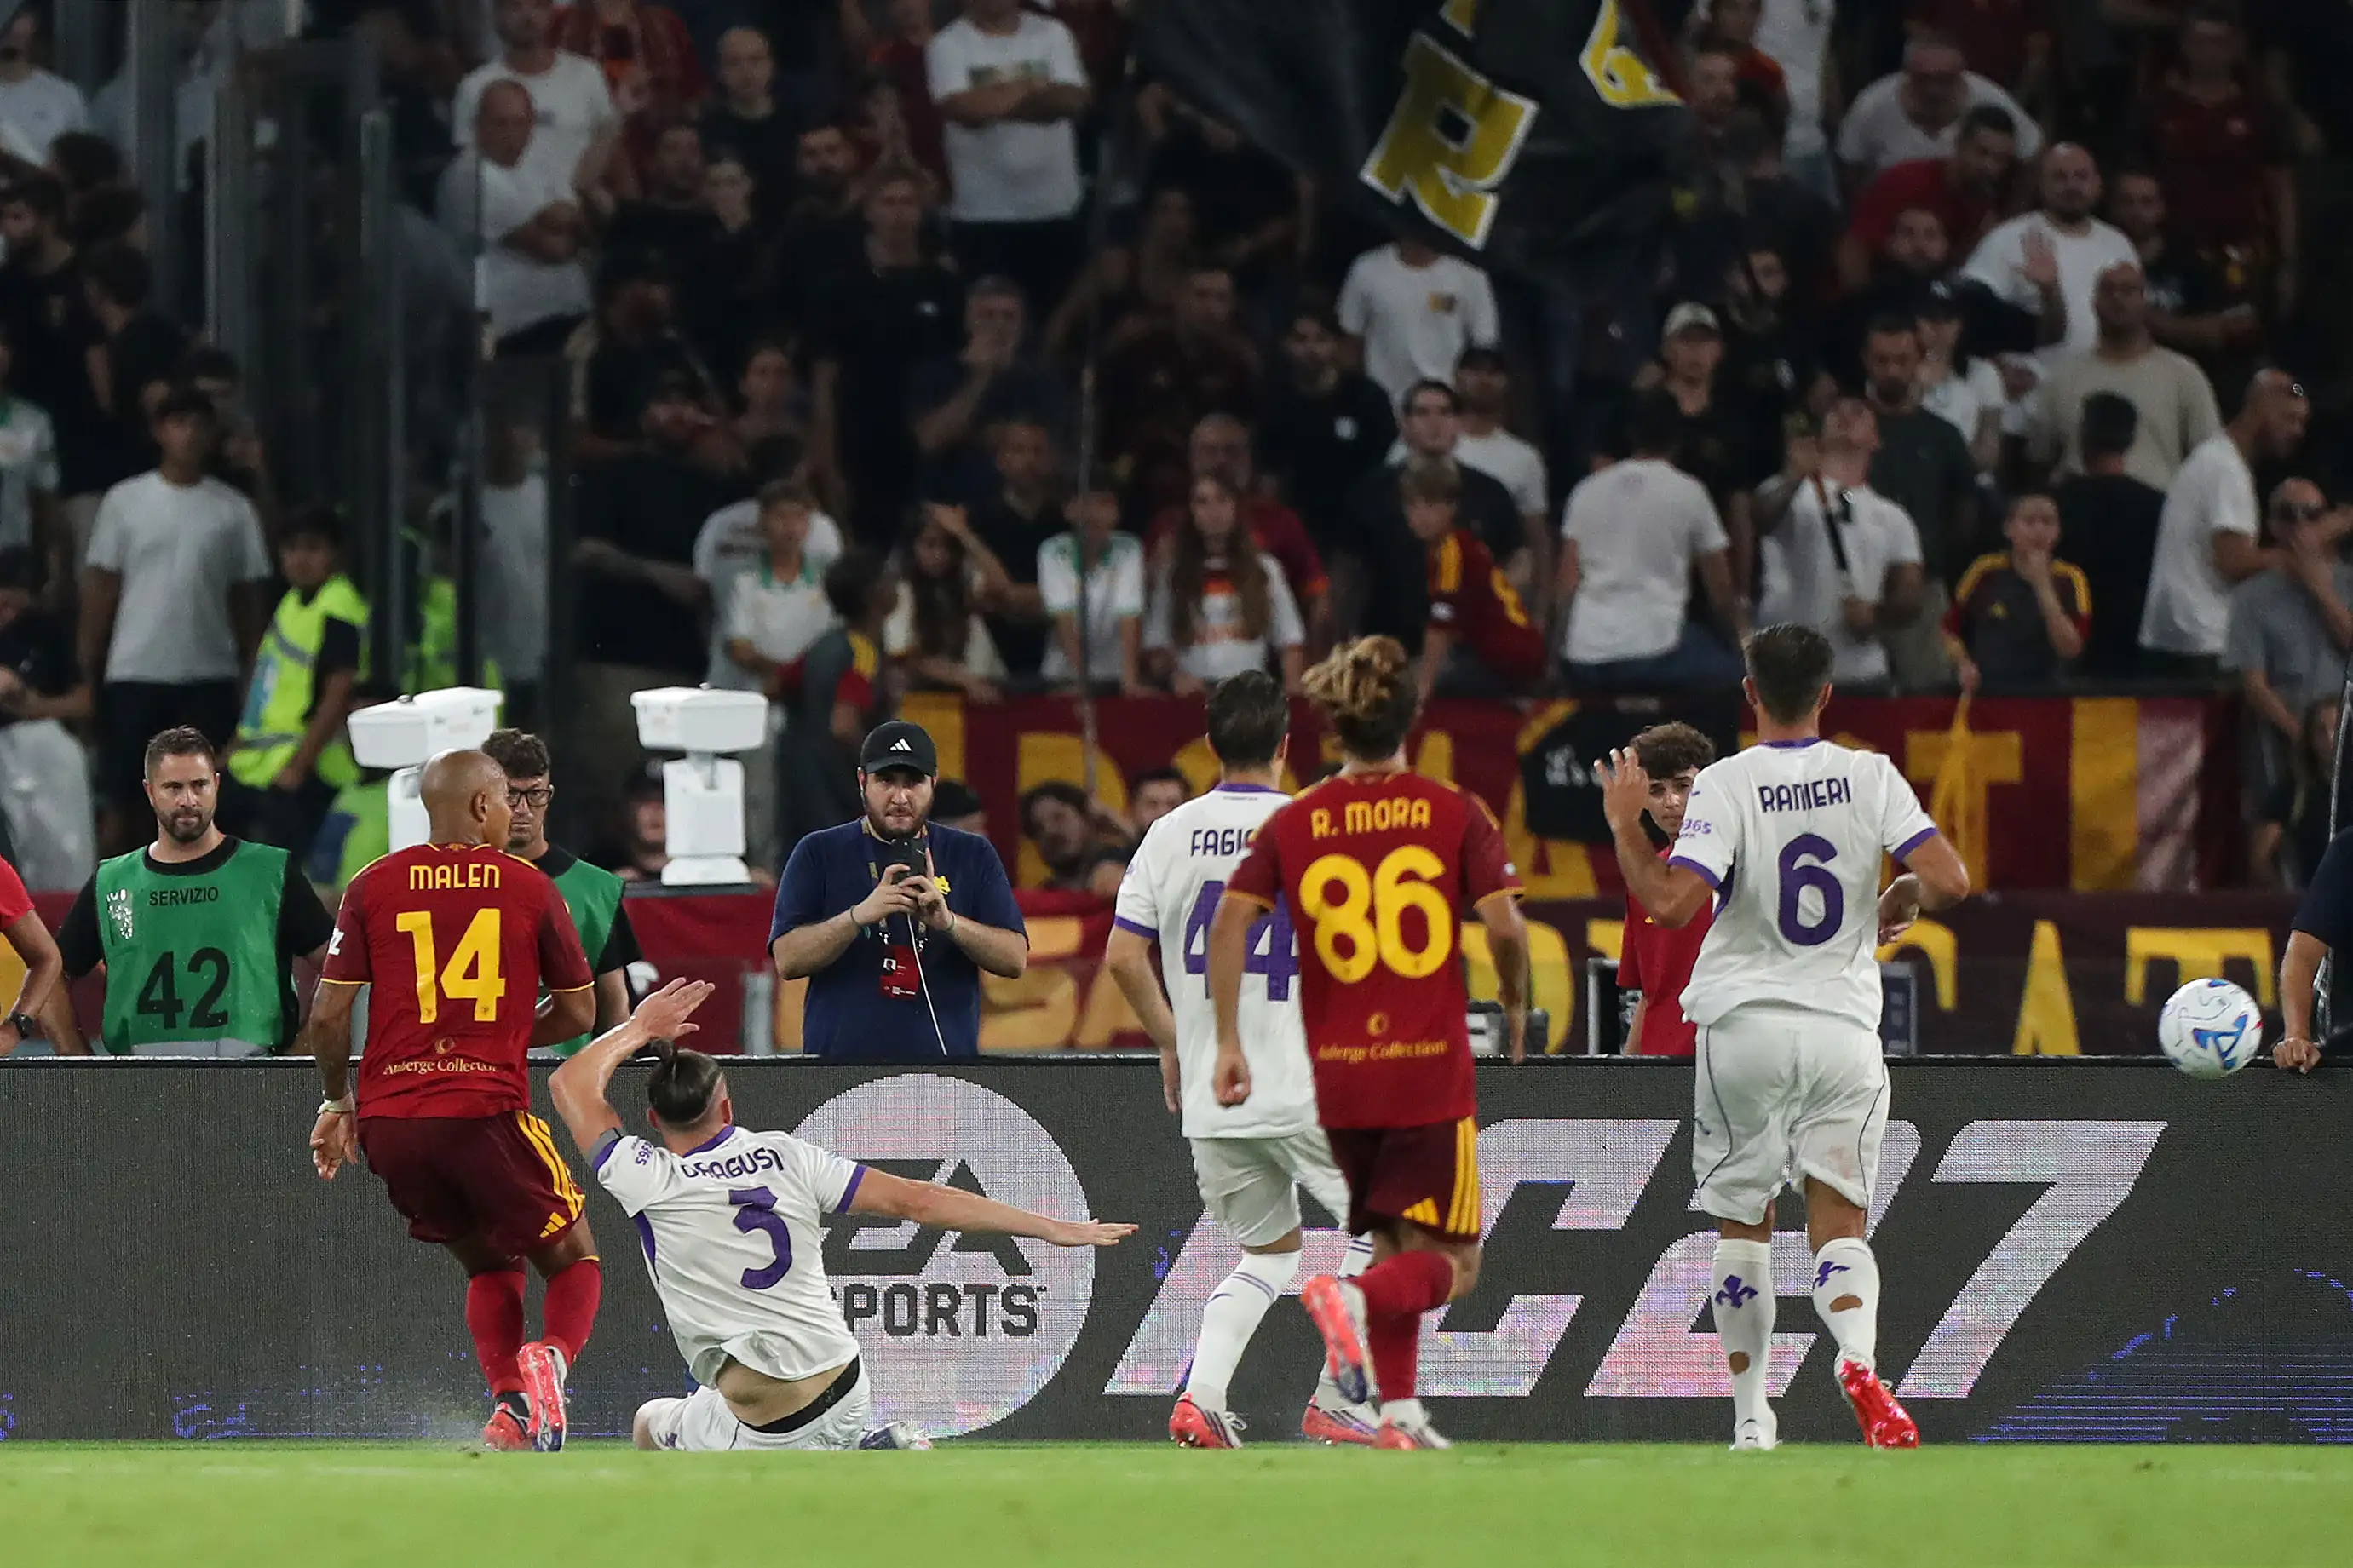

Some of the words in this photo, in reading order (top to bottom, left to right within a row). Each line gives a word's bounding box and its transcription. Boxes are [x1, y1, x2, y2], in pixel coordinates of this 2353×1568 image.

[1310, 808, 1339, 839] R.
[1344, 797, 1431, 836] MORA
[148, 887, 219, 906] SERVIZIO
[409, 863, 501, 890] MALEN
[1298, 844, 1453, 984] 86
[1777, 833, 1844, 945] 6
[137, 947, 231, 1029] 42
[396, 908, 506, 1024] 14
[728, 1186, 792, 1290] 3
[830, 1283, 1038, 1336] PORTS
